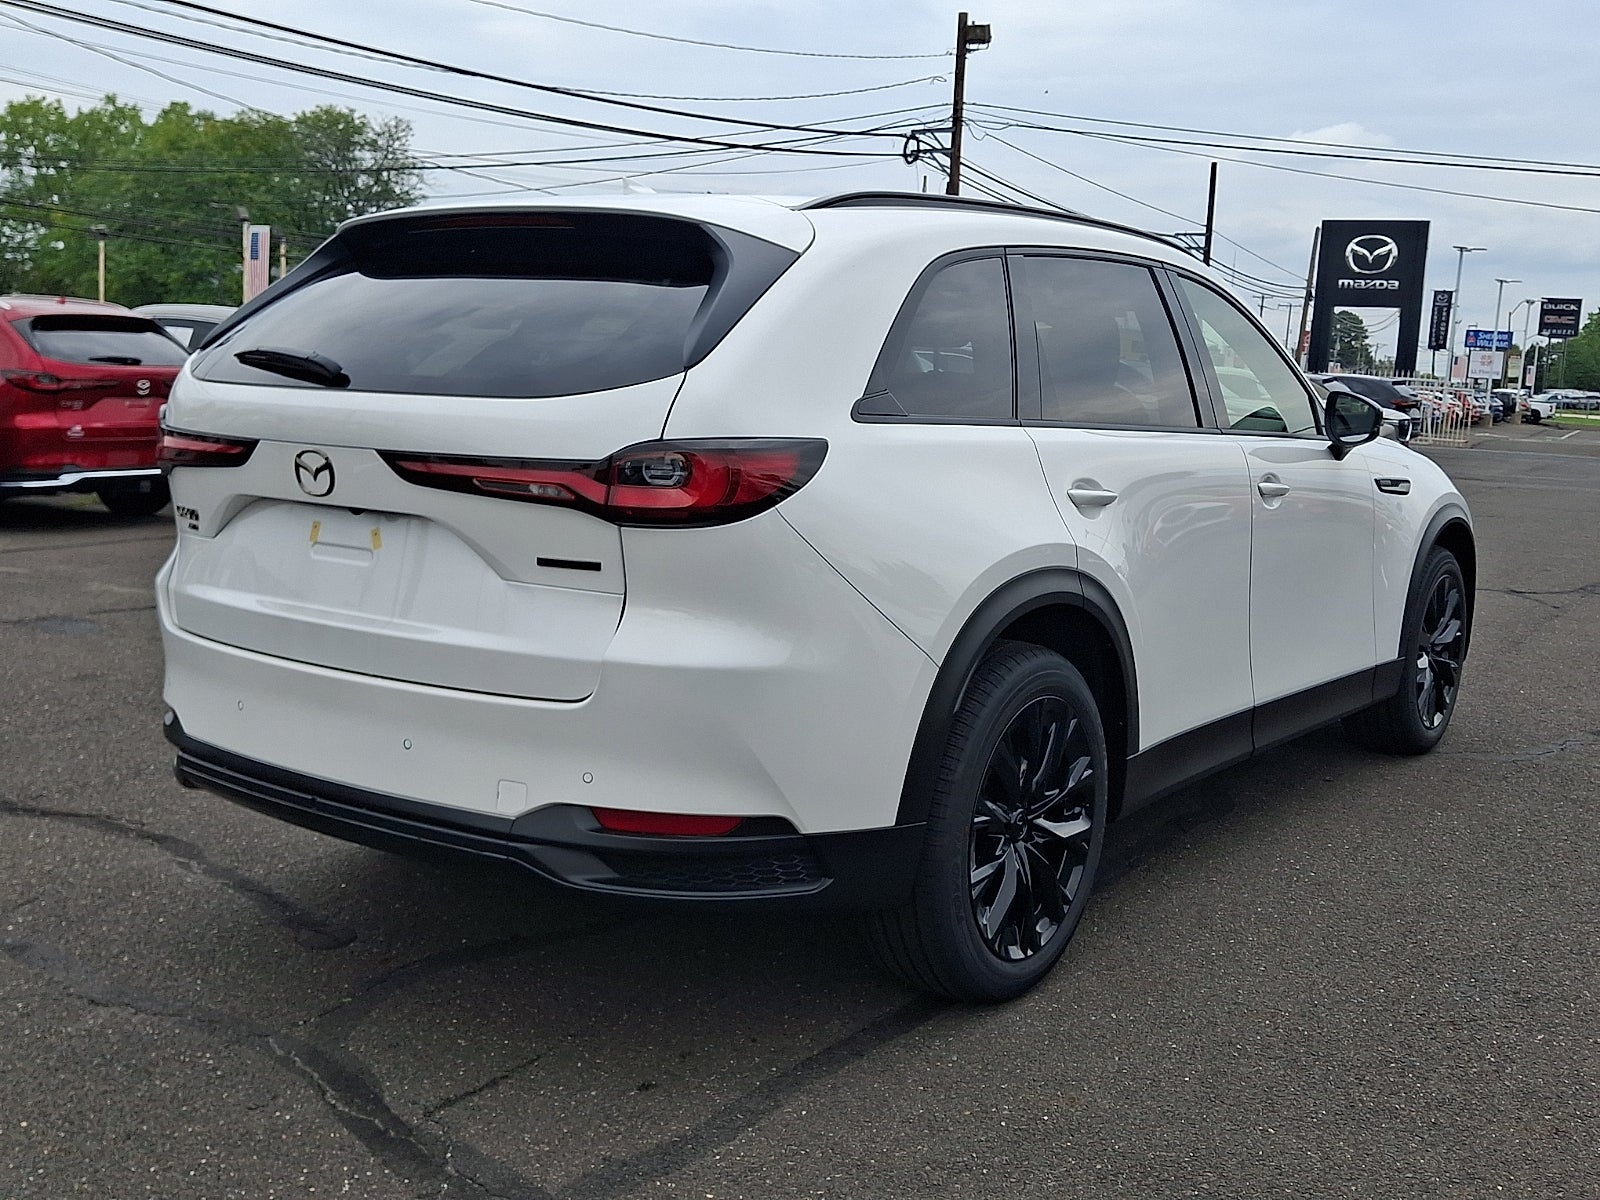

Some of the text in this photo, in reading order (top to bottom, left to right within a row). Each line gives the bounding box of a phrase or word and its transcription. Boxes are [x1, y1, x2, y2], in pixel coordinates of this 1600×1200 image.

[1338, 279, 1400, 290] mazda
[1543, 303, 1578, 311] BUICK
[1544, 315, 1576, 324] GMC
[1478, 331, 1509, 341] SHERIN
[1476, 338, 1509, 348] WILLAMS
